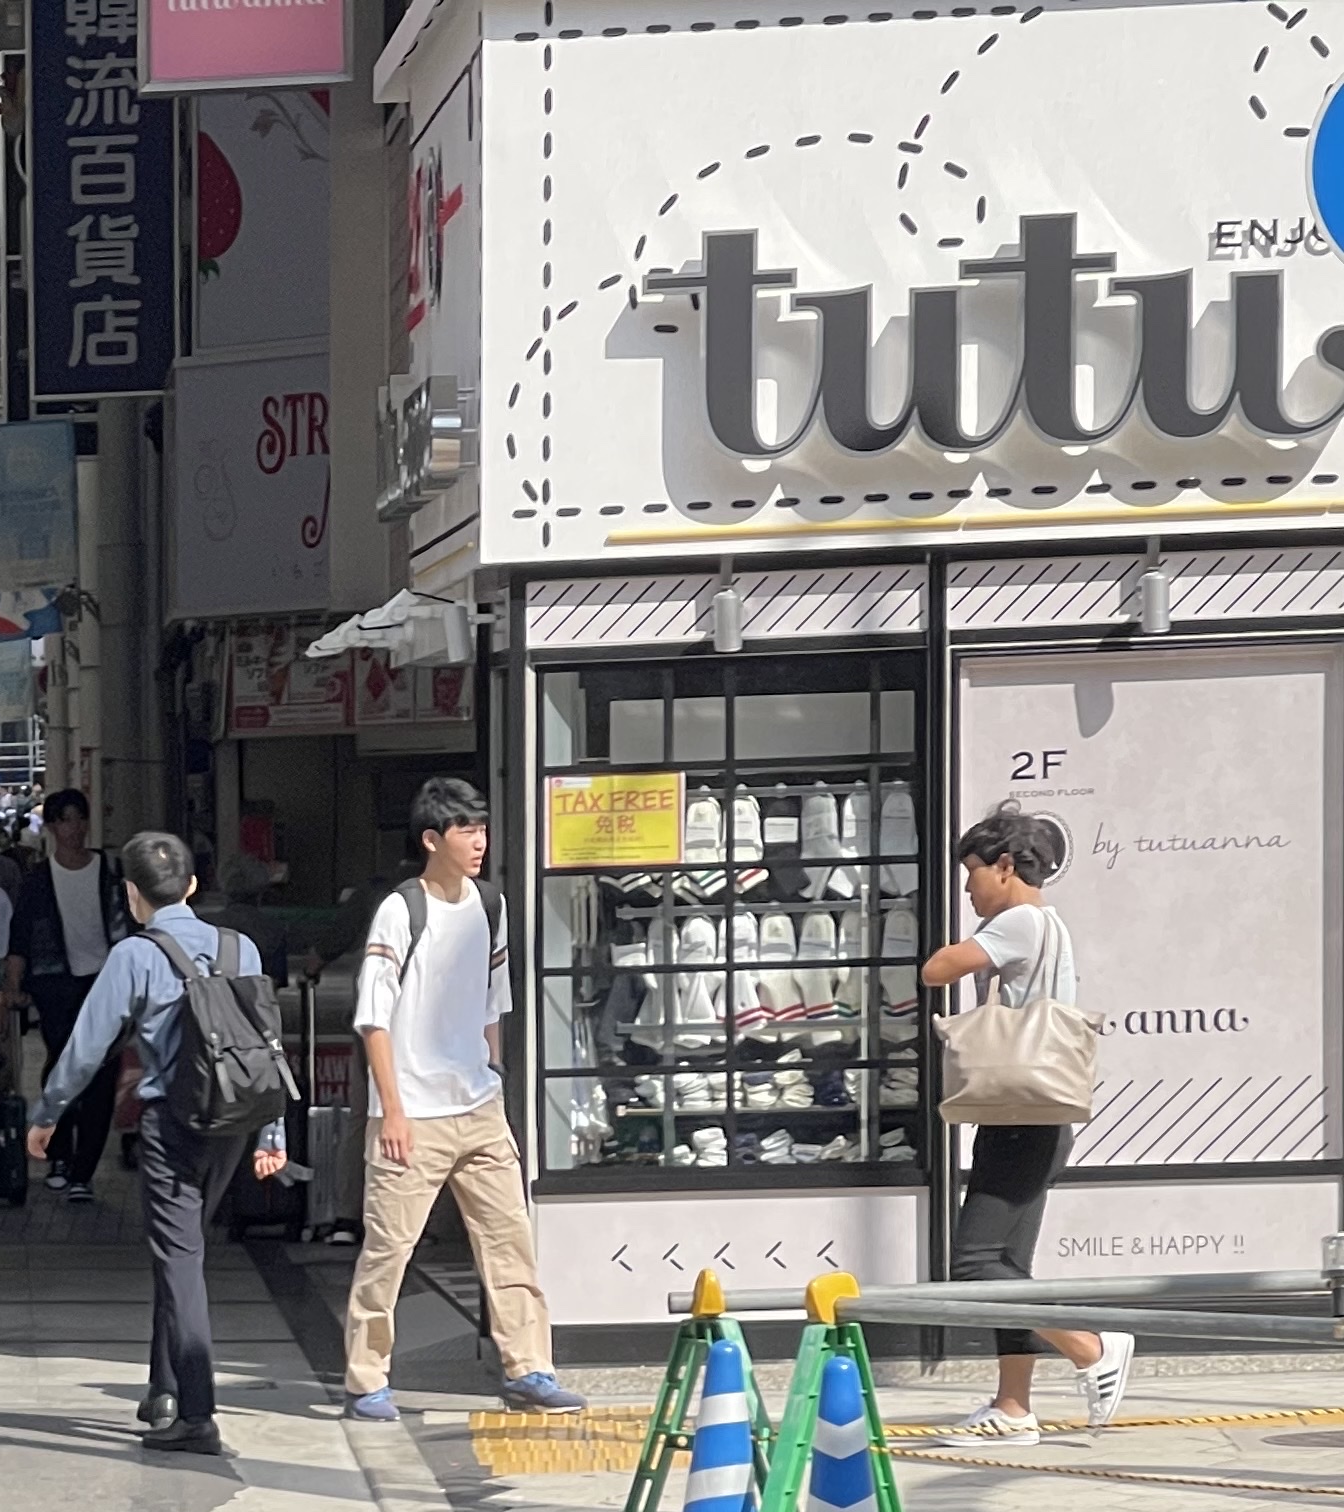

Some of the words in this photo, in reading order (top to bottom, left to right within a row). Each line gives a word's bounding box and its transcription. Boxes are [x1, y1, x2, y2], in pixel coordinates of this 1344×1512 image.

[1009, 749, 1068, 781] 2F
[554, 790, 604, 812] TAX
[609, 789, 675, 812] FREE
[1009, 788, 1055, 799] SECOND
[1057, 788, 1095, 797] FLOOR
[595, 815, 636, 834] 免税
[1091, 822, 1126, 870] by
[1133, 834, 1292, 853] tutuanna
[1057, 1236, 1124, 1258] SMILE
[1130, 1237, 1145, 1255] &
[1150, 1234, 1225, 1255] HAPPY
